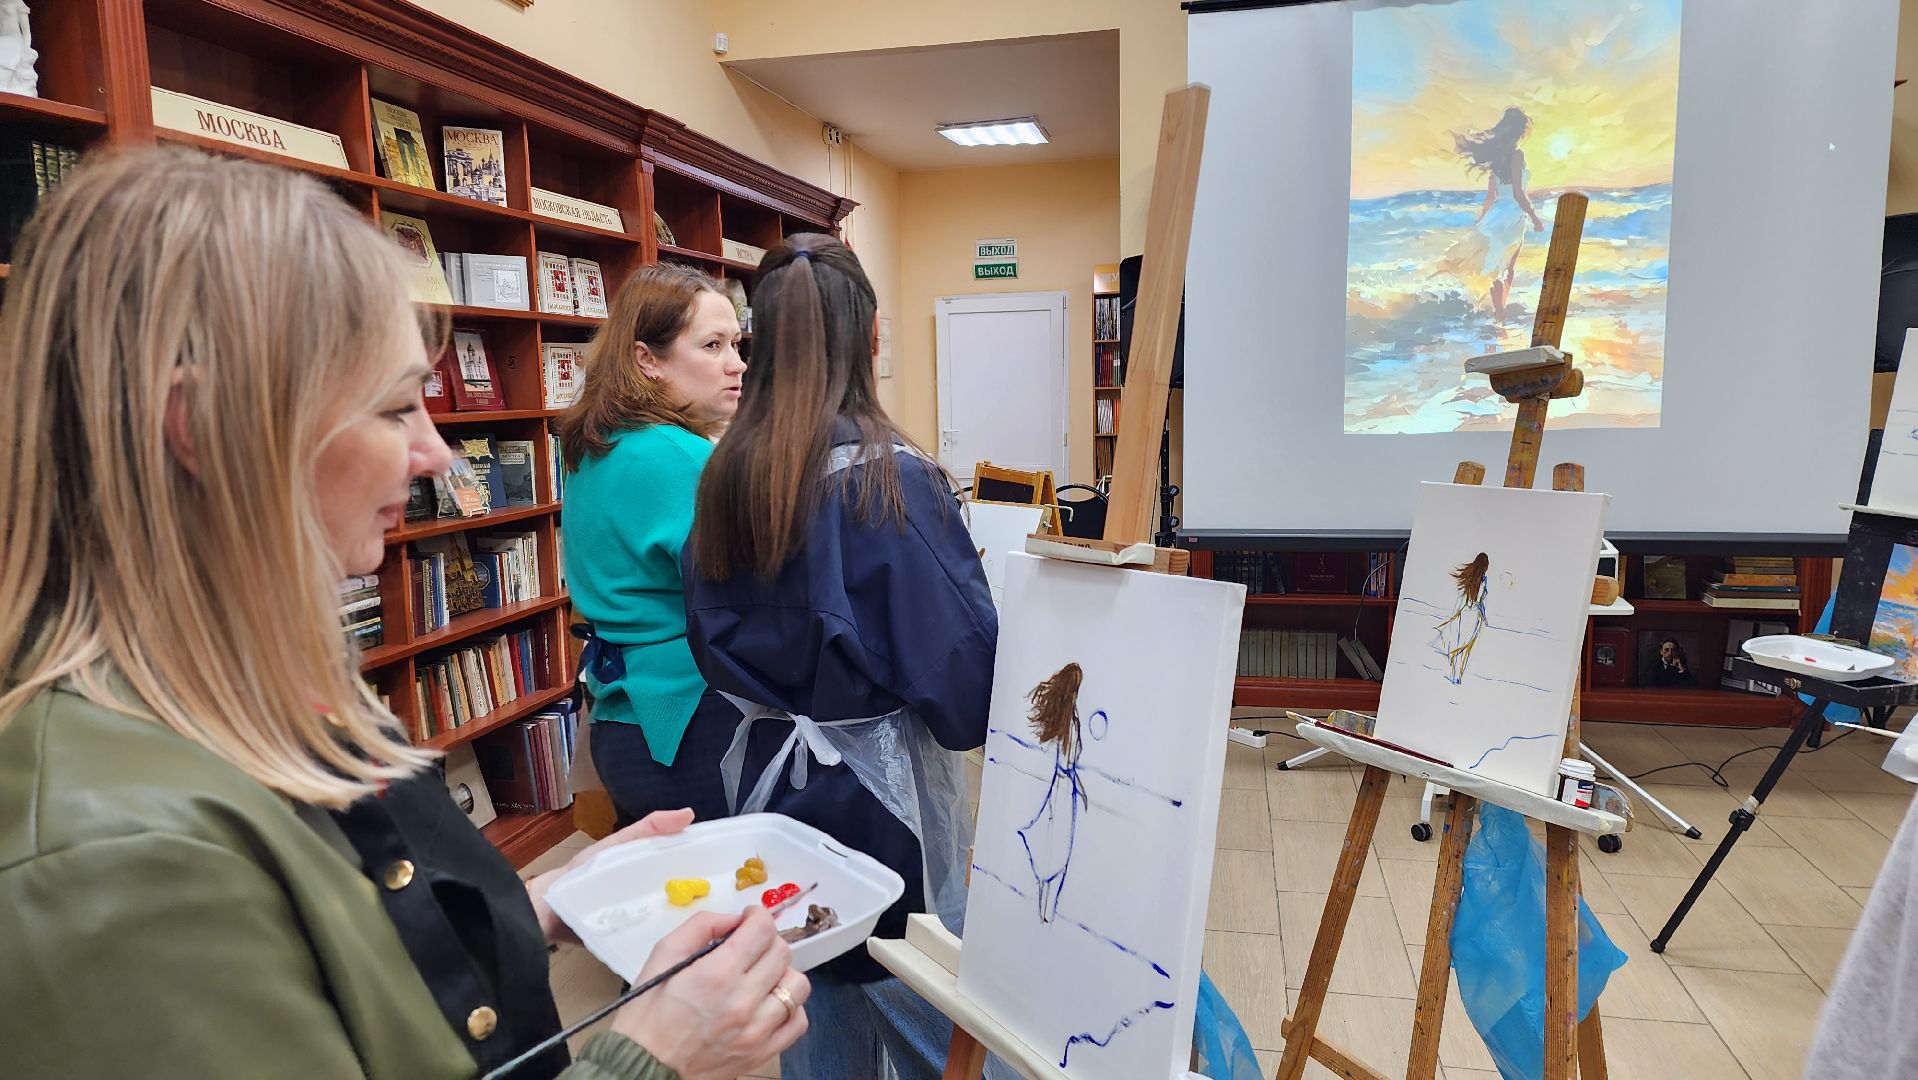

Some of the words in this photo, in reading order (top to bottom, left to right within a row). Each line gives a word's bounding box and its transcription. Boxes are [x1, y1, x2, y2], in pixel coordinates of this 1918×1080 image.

[194, 108, 288, 151] МОСКВА
[445, 129, 499, 145] МОСКВА
[532, 196, 581, 219] МОСКОВСКАЯ
[582, 209, 613, 225] ОБЛАСТЬ
[980, 245, 1014, 256] ВЫХОД
[977, 265, 1015, 277] ВЫХОД
